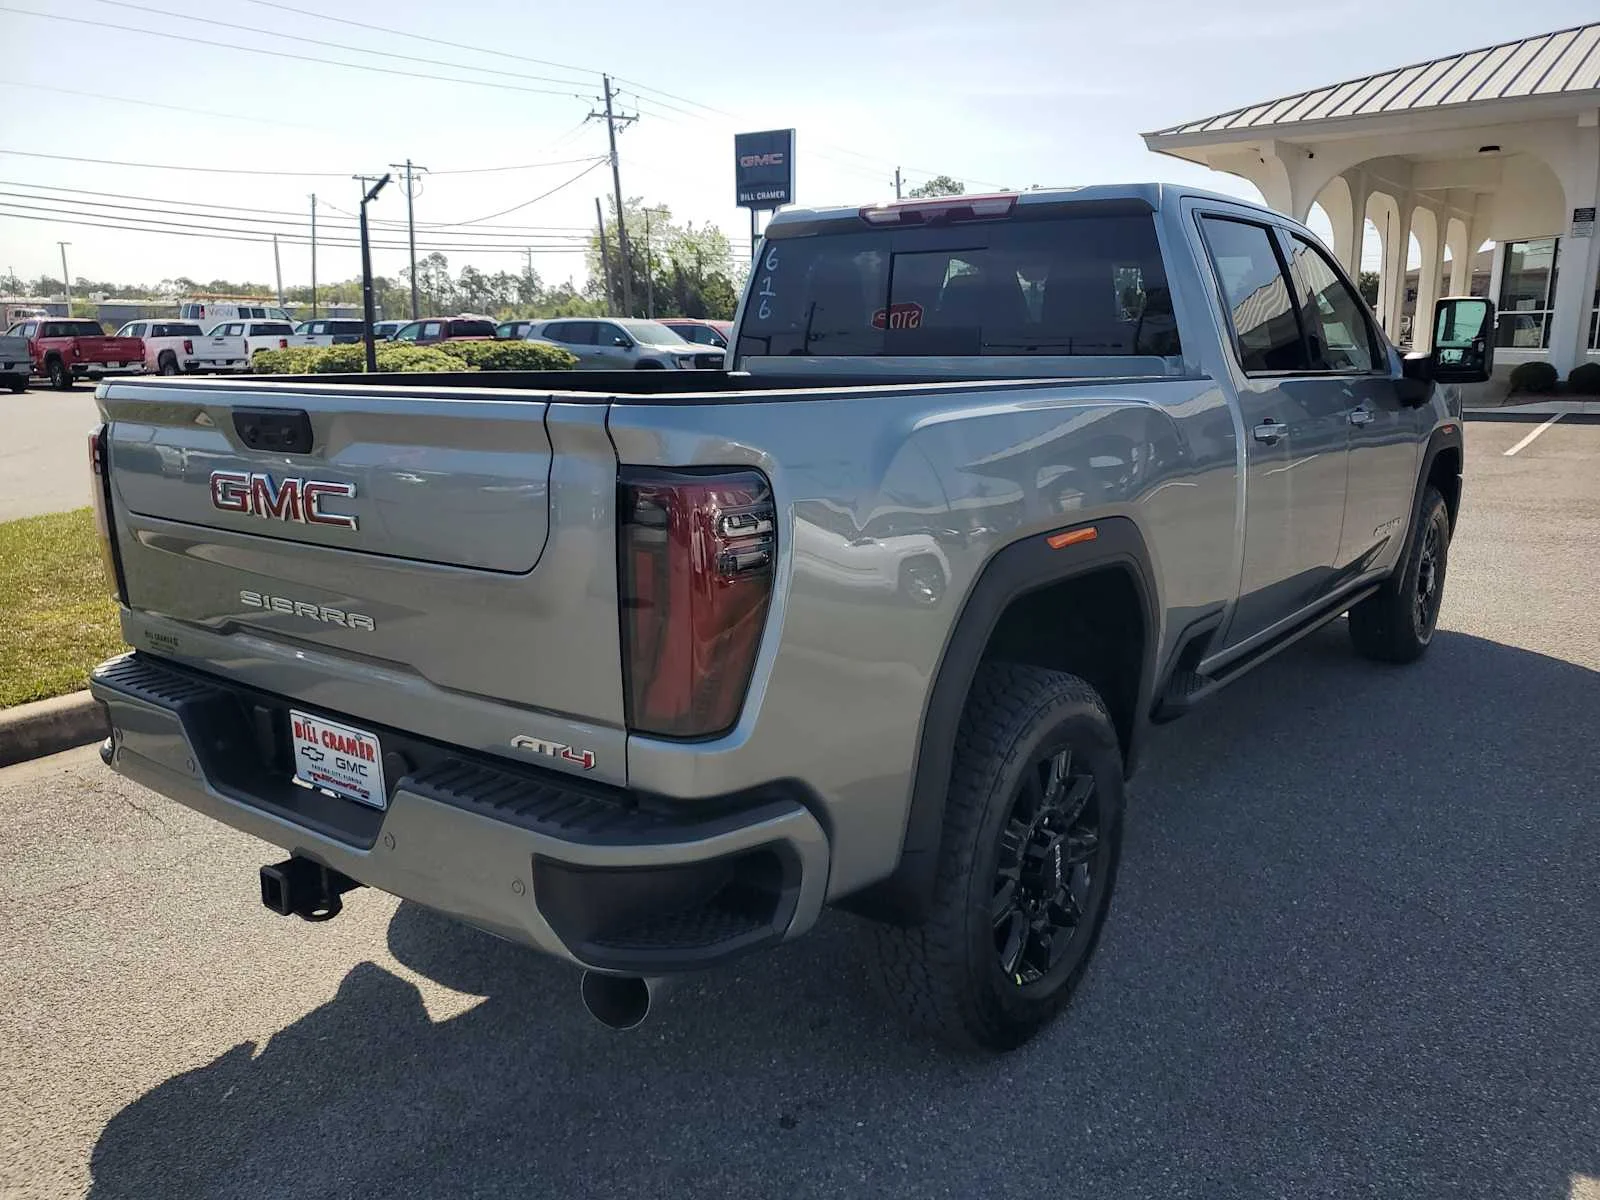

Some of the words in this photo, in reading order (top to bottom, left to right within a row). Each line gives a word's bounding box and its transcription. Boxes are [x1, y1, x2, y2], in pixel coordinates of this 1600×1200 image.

[740, 153, 784, 168] GMC
[740, 192, 755, 202] BILL
[756, 190, 785, 200] CRAMER
[209, 469, 360, 532] GMC
[239, 589, 377, 633] SIERRA
[294, 720, 319, 745] BILL
[321, 730, 376, 763] CRAMER
[511, 734, 596, 771] AT4
[335, 757, 369, 778] GMC
